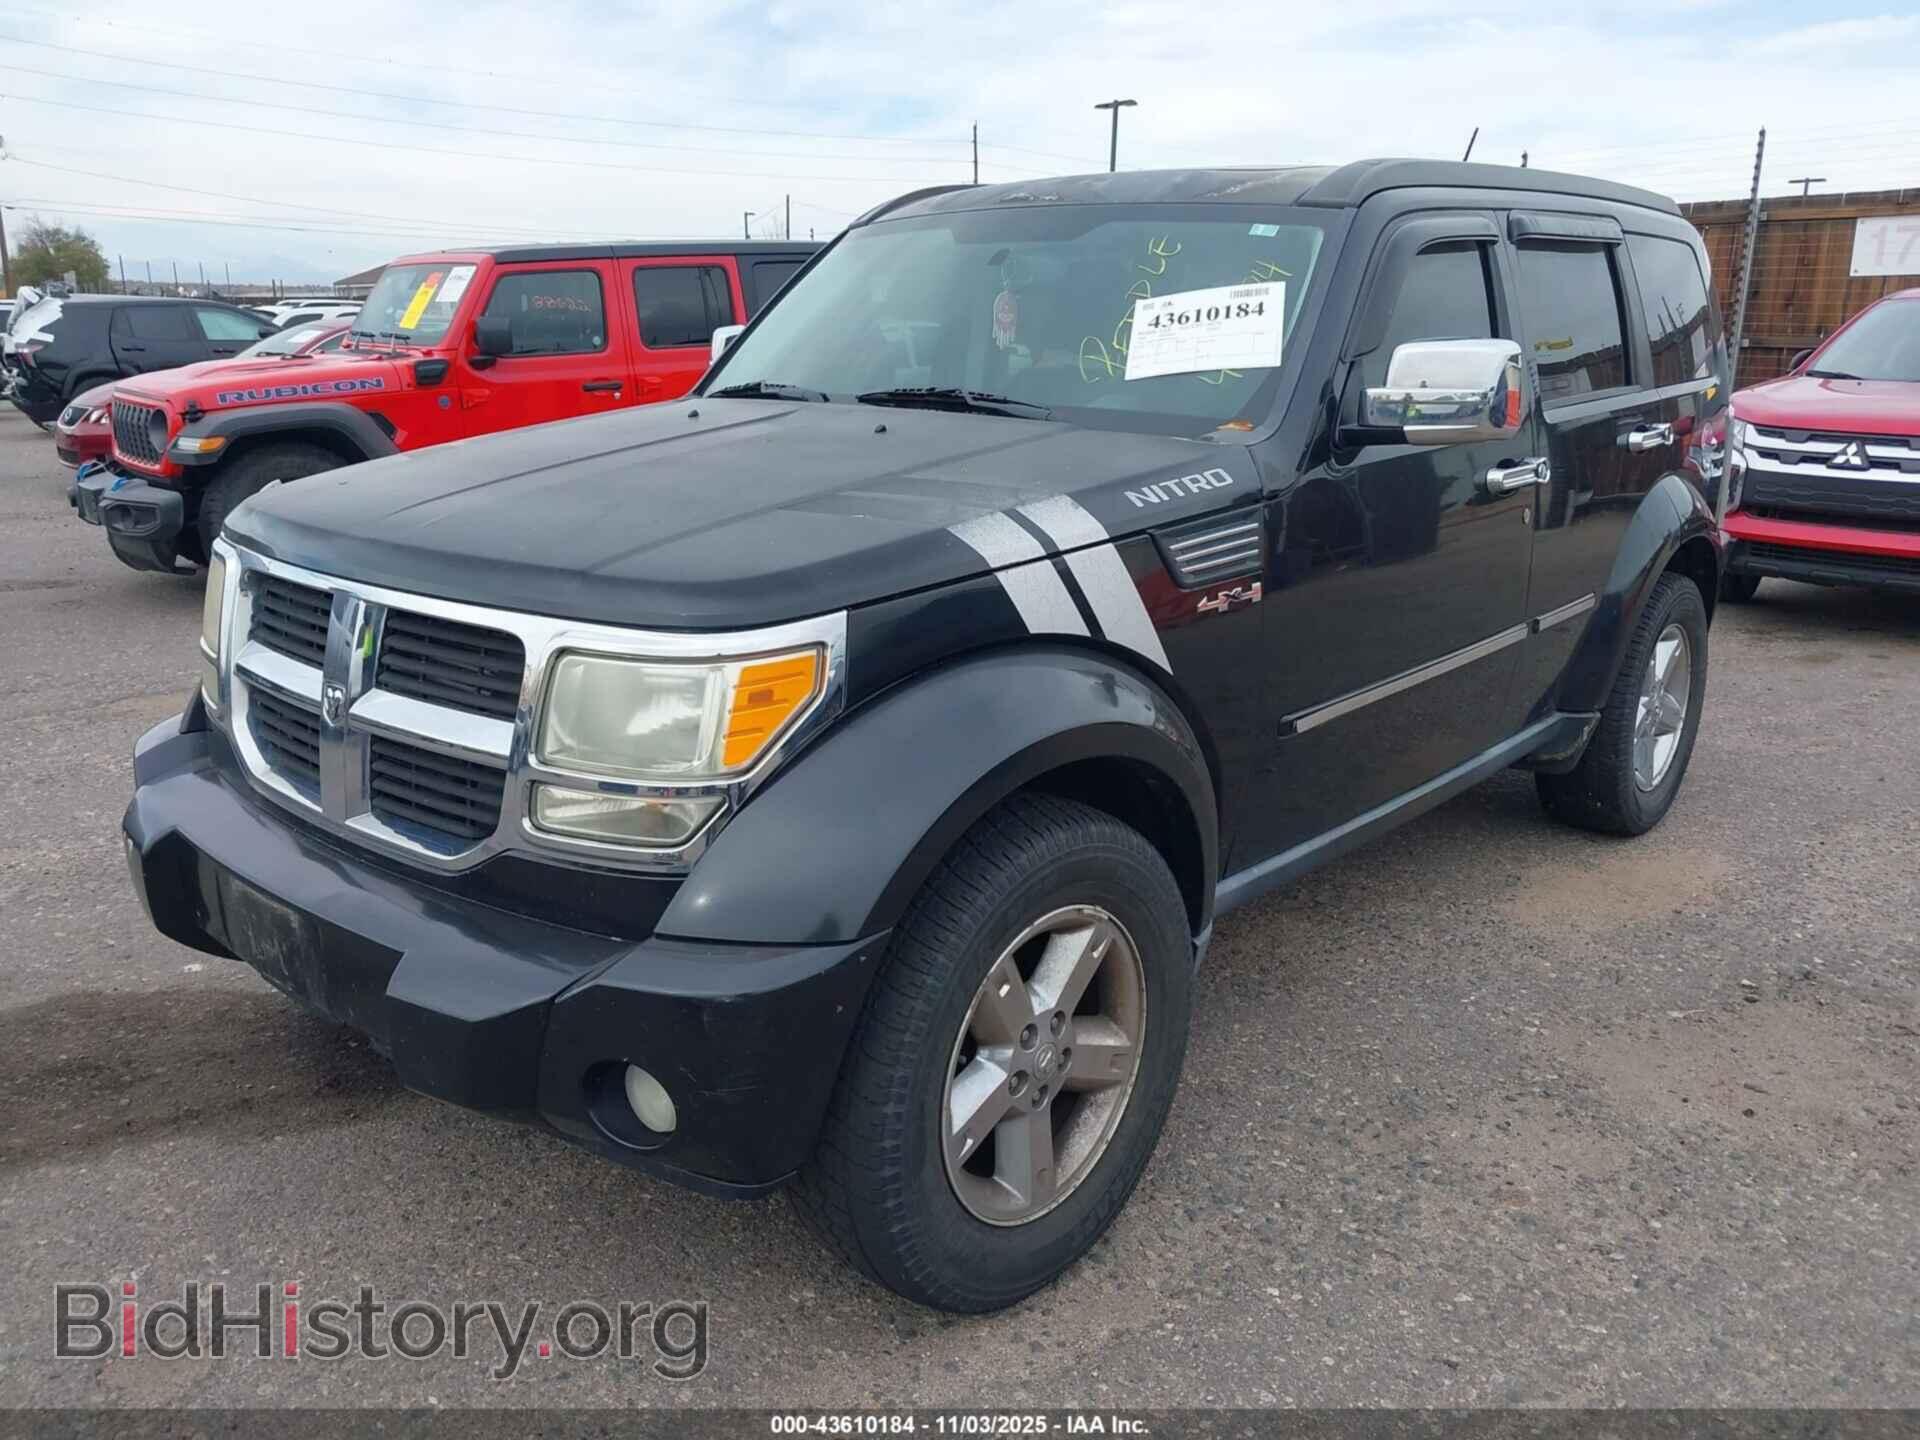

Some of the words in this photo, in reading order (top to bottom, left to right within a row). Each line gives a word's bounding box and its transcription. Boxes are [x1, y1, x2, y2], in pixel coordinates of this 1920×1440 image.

[1147, 300, 1265, 329] 43610184
[217, 376, 385, 405] RUBICON
[1123, 467, 1234, 507] NITRO
